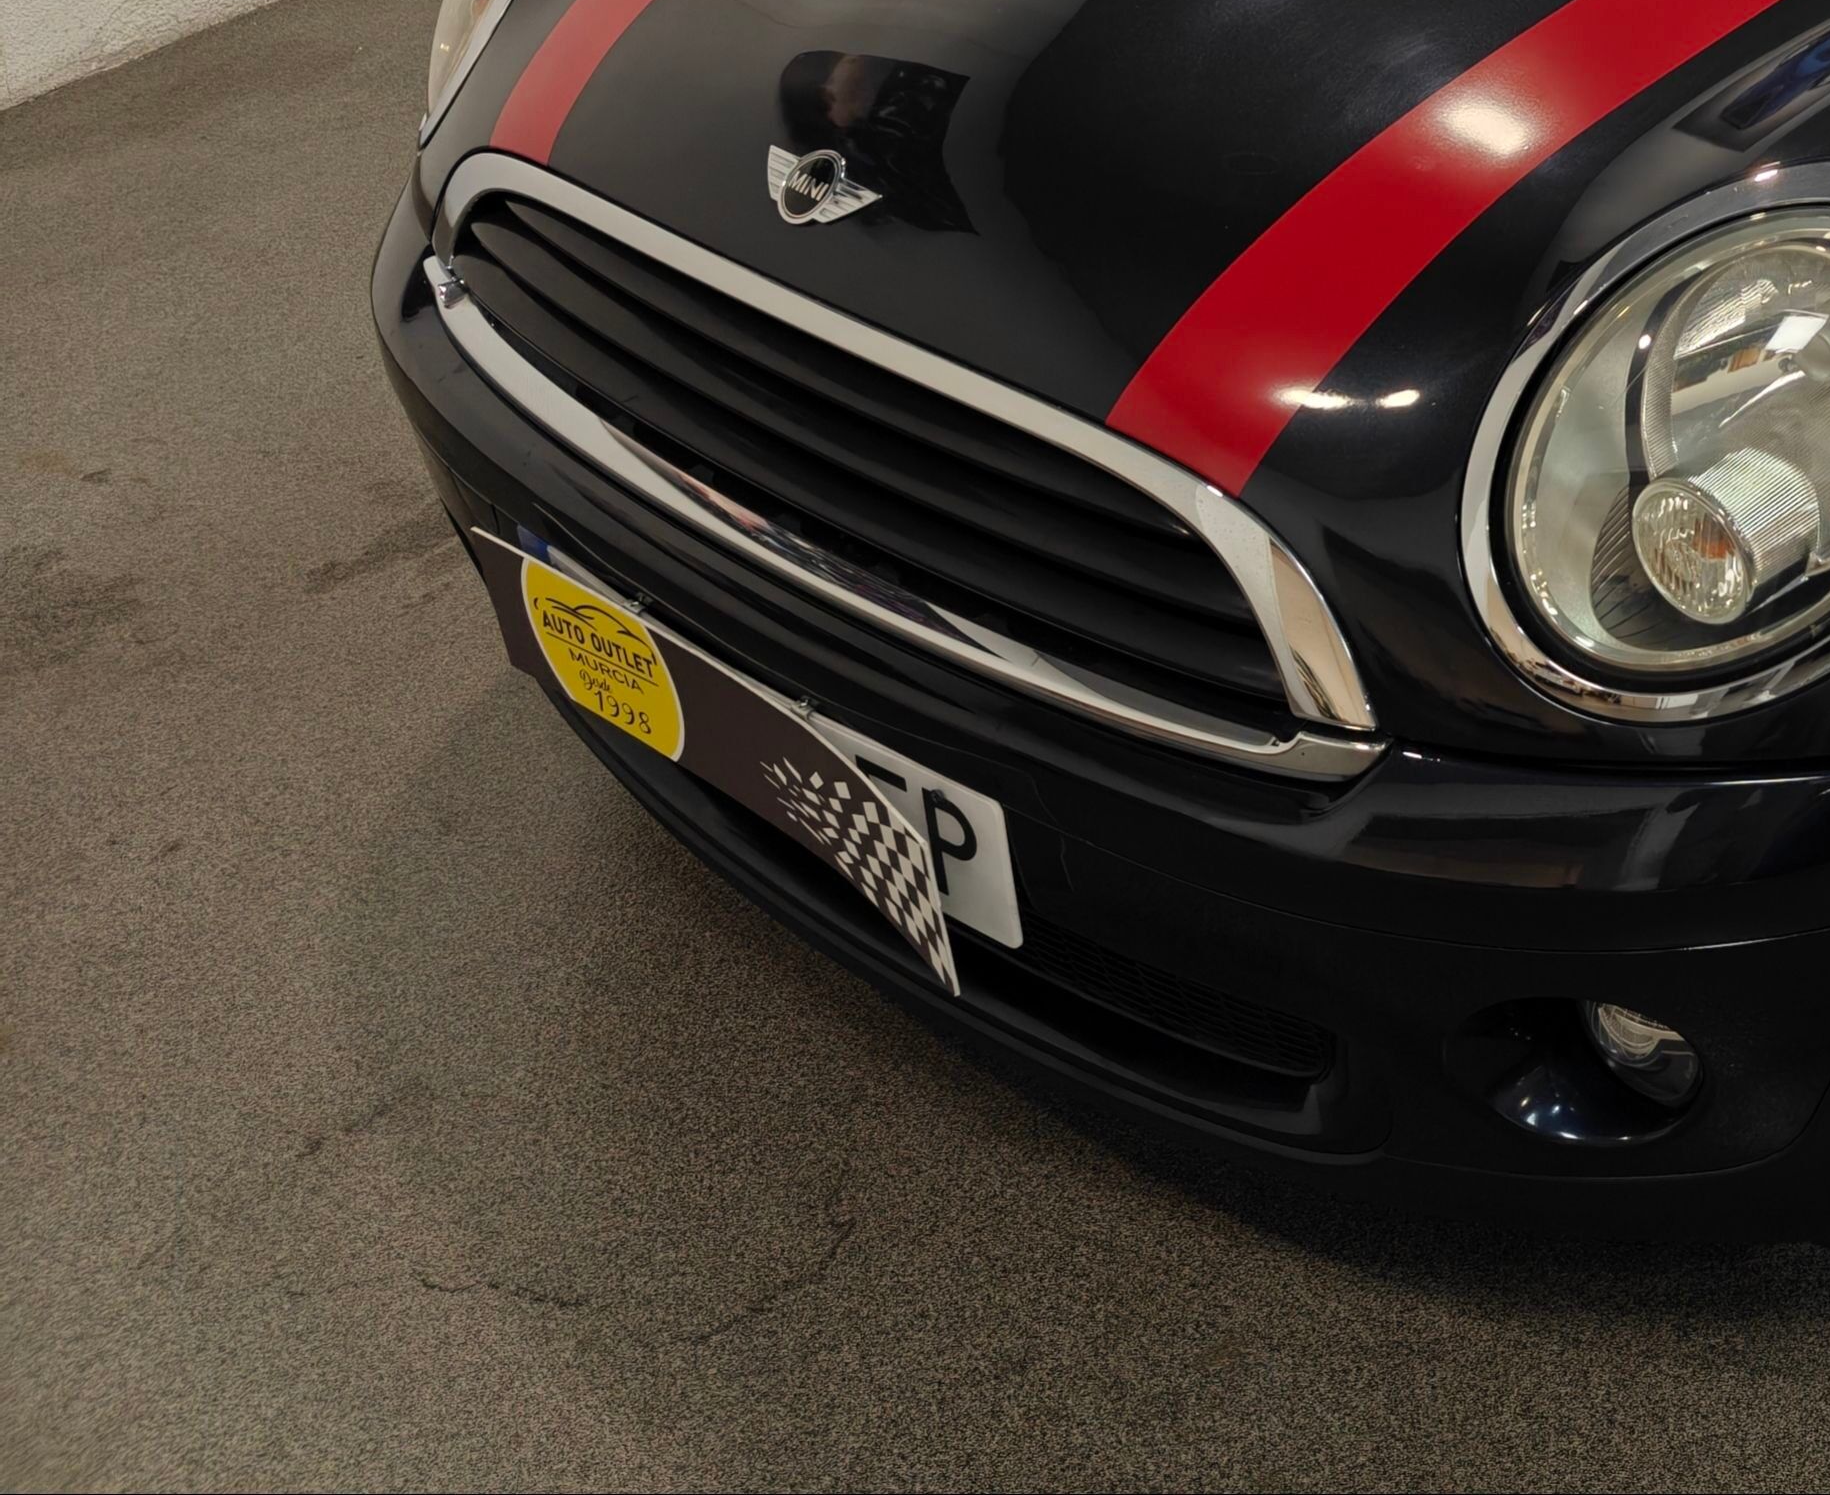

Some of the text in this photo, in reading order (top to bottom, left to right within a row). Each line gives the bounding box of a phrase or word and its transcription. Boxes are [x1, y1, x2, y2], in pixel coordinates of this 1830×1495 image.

[788, 170, 829, 201] MINI
[543, 610, 653, 678] AUTO OUTLET
[569, 648, 645, 695] MURCIA
[579, 669, 612, 693] Desde
[595, 691, 652, 735] 1998
